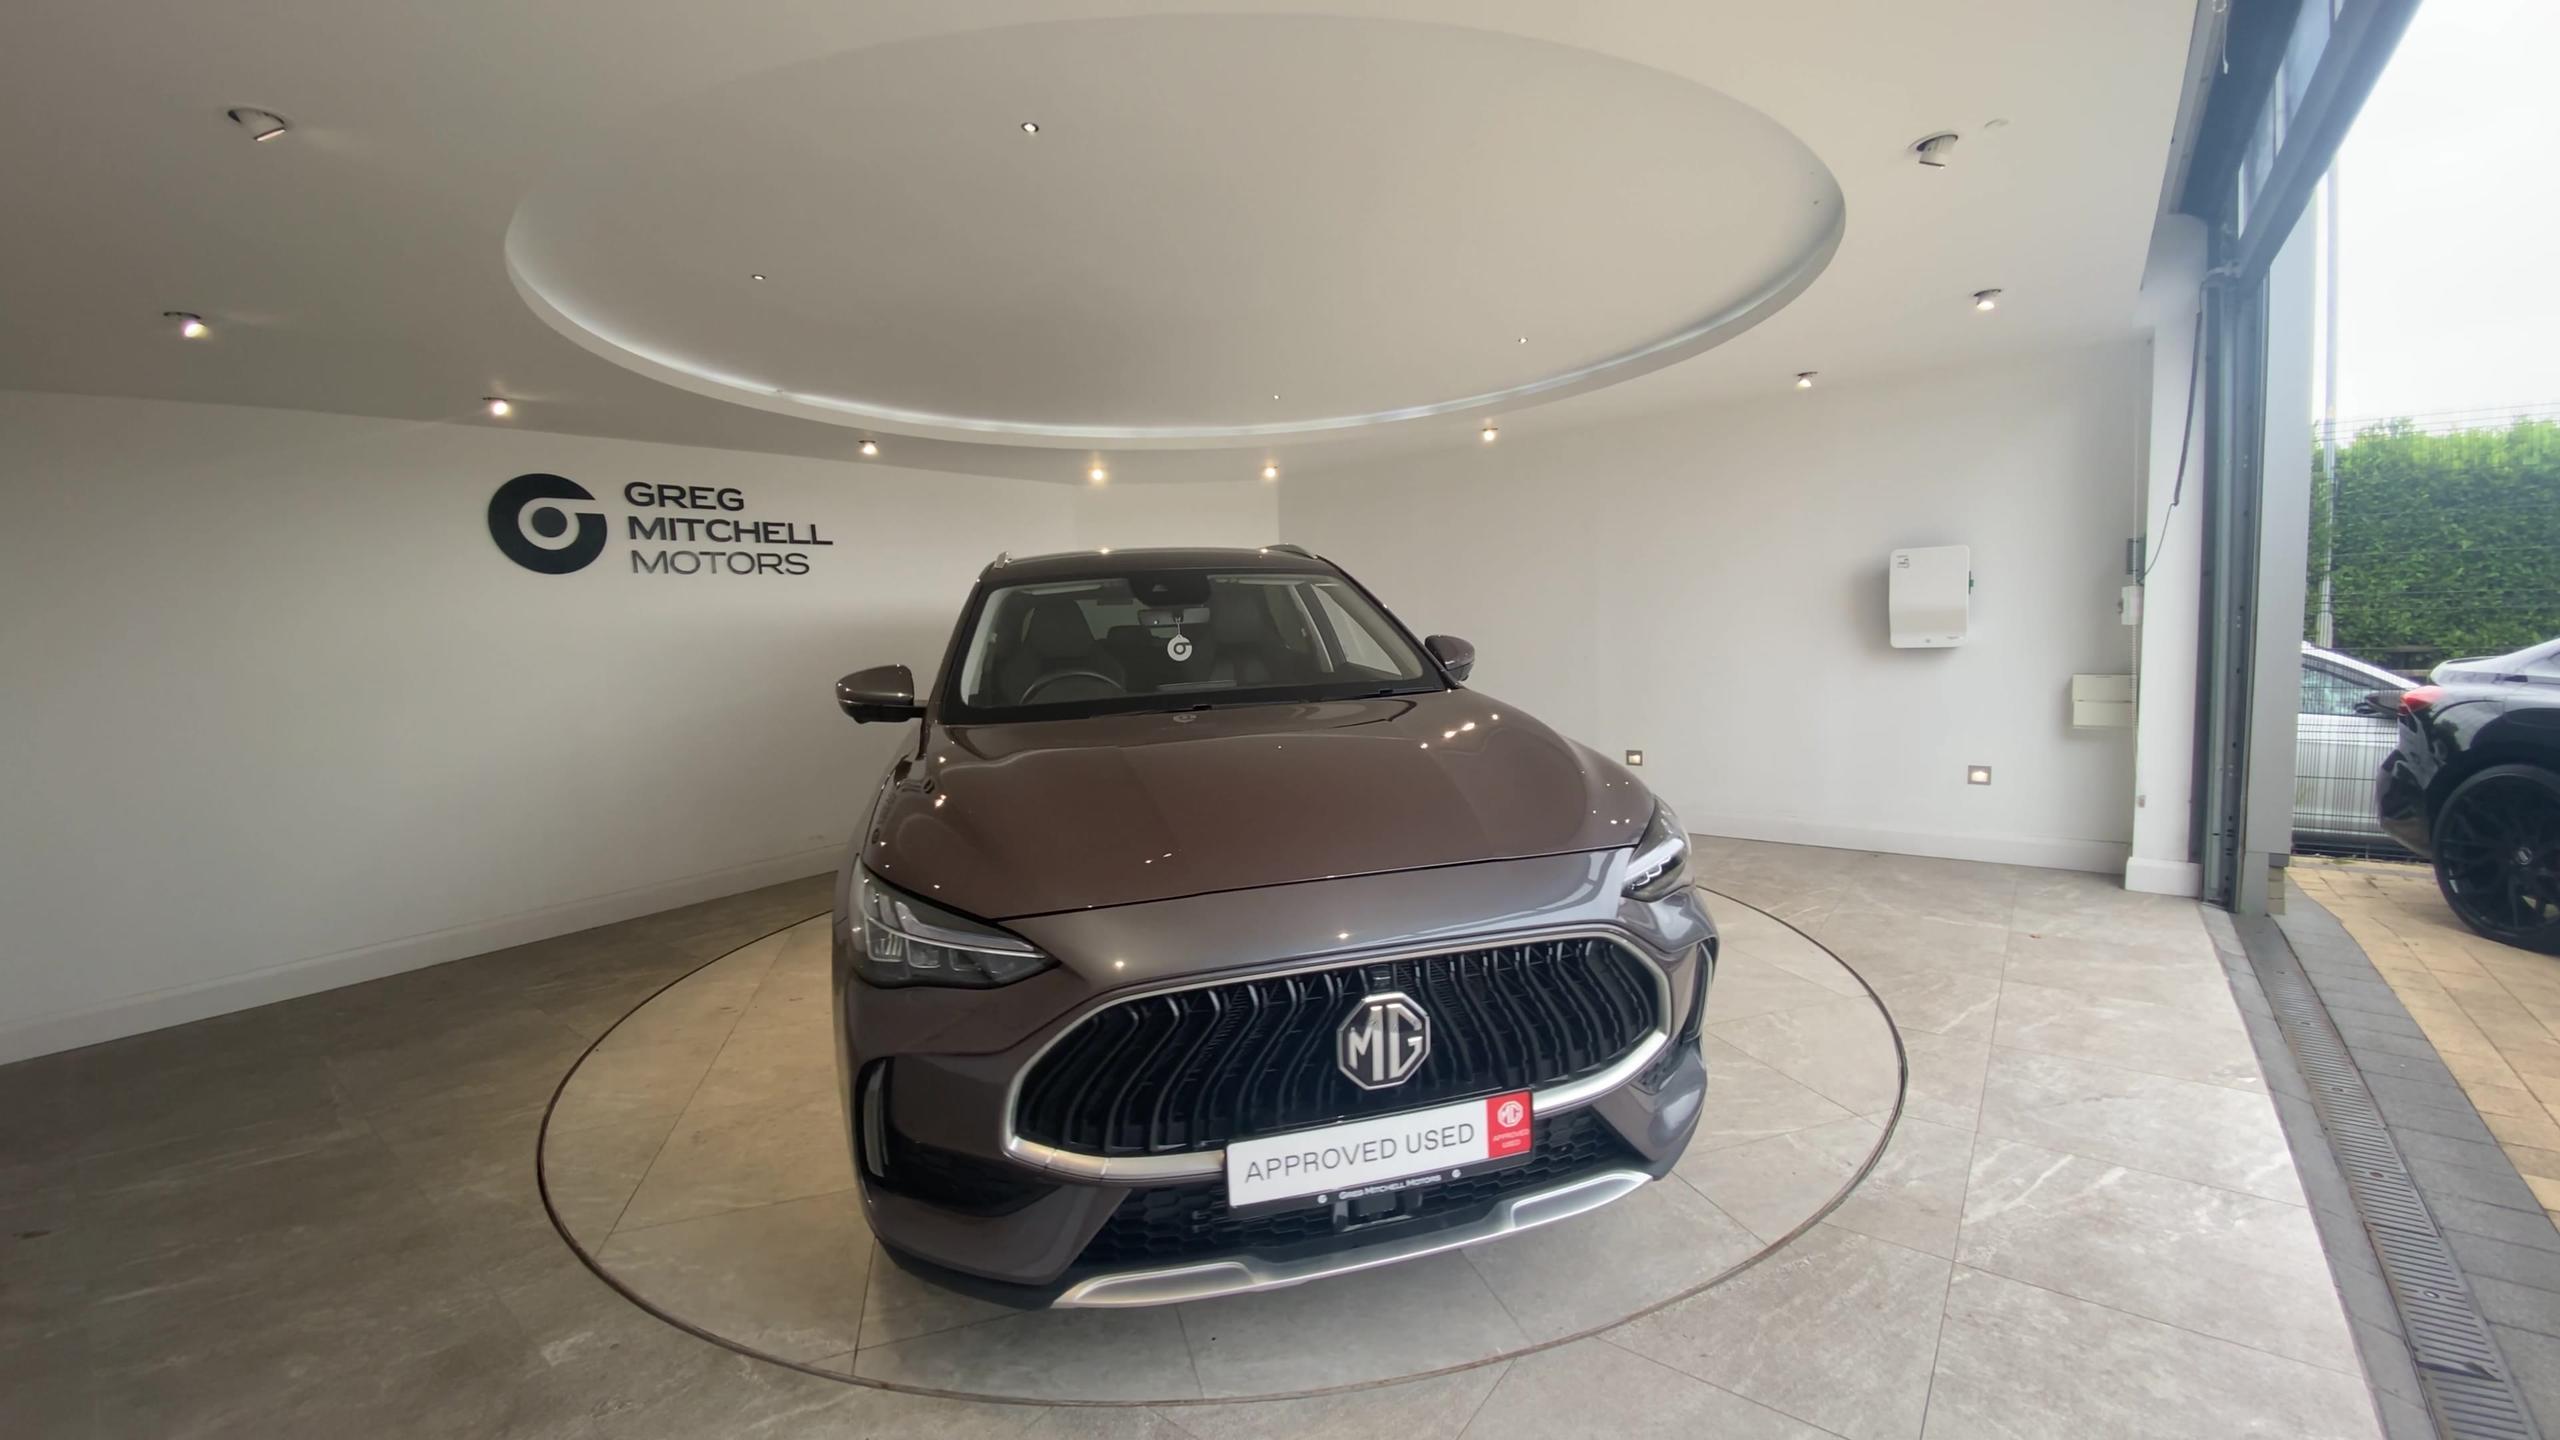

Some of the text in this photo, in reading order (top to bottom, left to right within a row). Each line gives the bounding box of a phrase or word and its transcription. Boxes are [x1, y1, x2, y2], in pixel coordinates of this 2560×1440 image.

[624, 481, 745, 511] GREG
[628, 515, 833, 546] MITCHELL
[631, 550, 810, 575] MOTORS
[1346, 1001, 1424, 1082] MG
[1244, 1123, 1475, 1184] APPROVED USED
